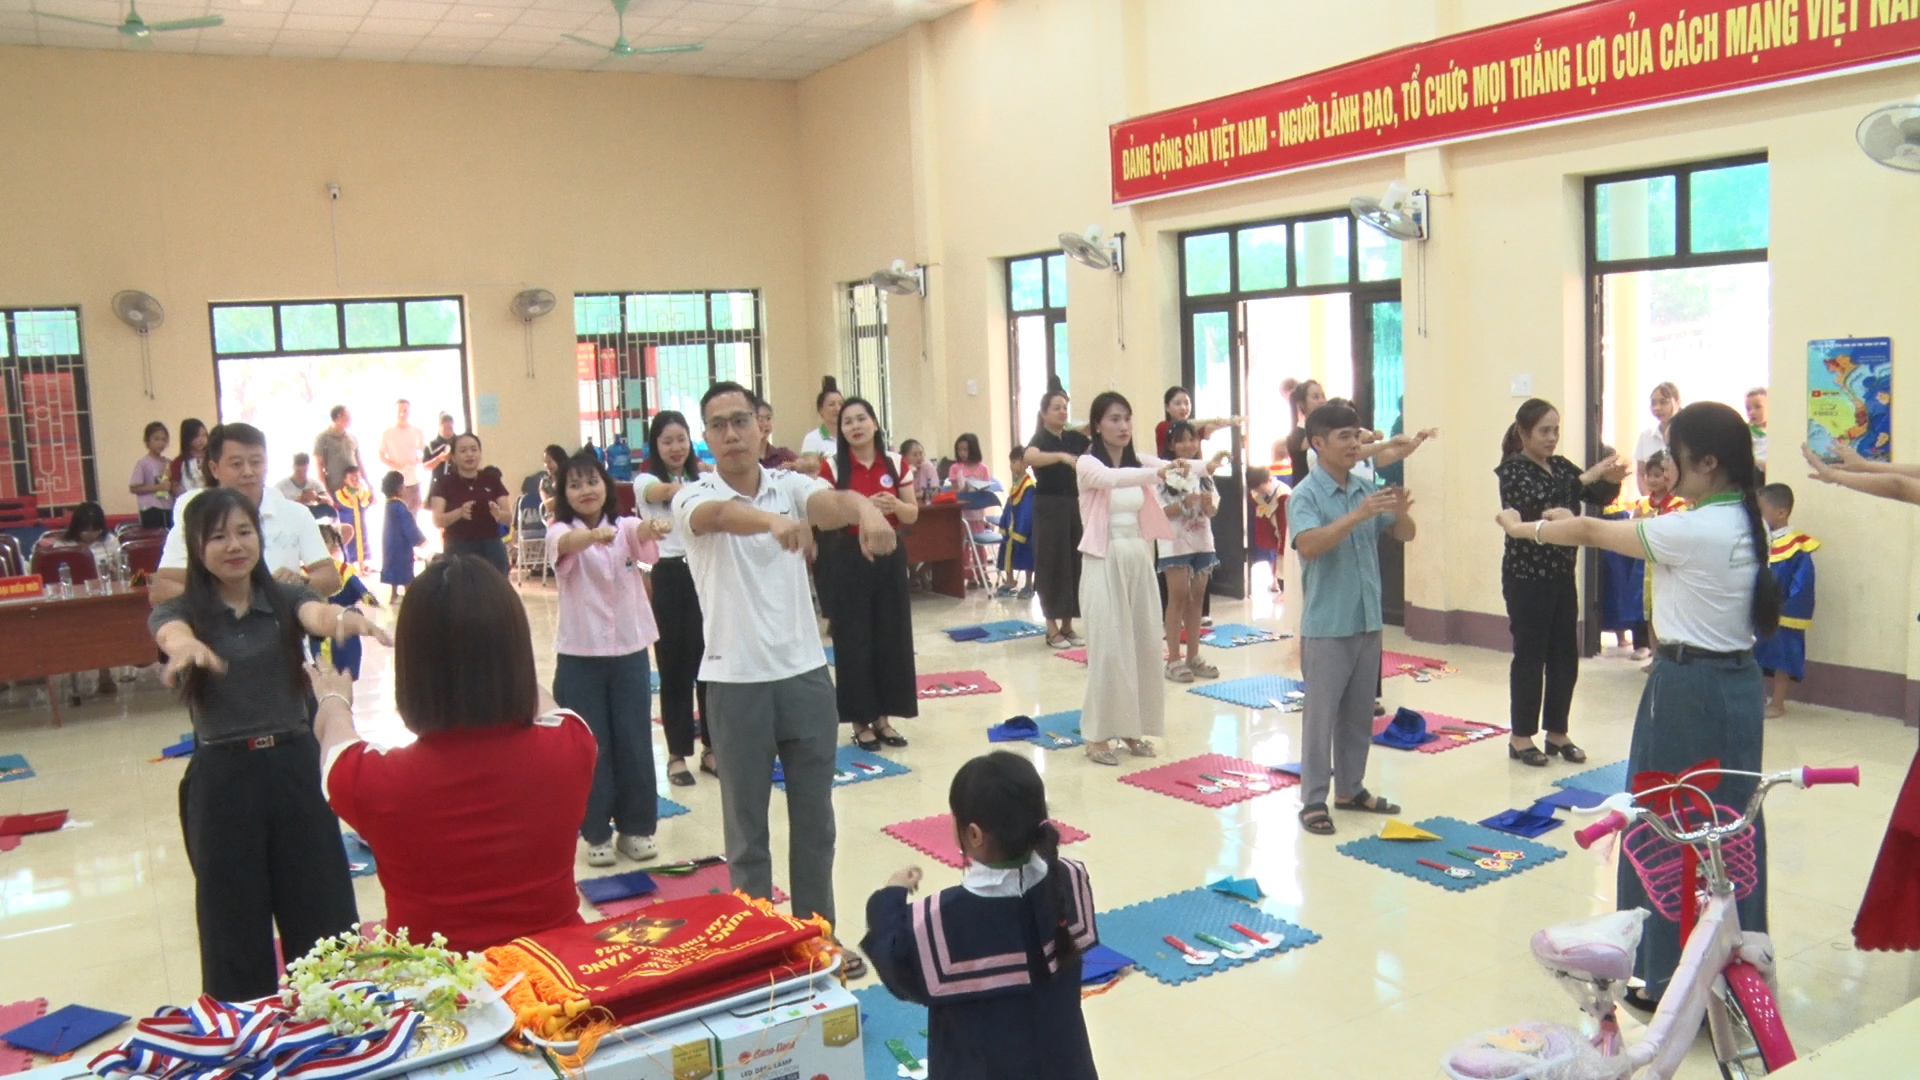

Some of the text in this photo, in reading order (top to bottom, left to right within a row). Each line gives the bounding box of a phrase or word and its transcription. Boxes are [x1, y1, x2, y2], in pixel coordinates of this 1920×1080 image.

[1122, 134, 1151, 181] ĐẢNG
[1153, 134, 1182, 180] CỘNG
[1185, 118, 1208, 168] SẢN
[1211, 118, 1236, 167] VIỆT
[1238, 116, 1267, 156] NAM
[1279, 95, 1319, 147] NGƯỜI
[1323, 92, 1360, 137] LÃNH
[1364, 86, 1398, 136] ĐẠO,
[1401, 63, 1420, 121] TỔ
[1425, 60, 1468, 117] CHỨC
[1472, 60, 1506, 113] MỌI
[1510, 37, 1570, 99] THẮNG
[1576, 31, 1606, 95] LỢI
[1612, 11, 1654, 79] CỦA
[1659, 9, 1718, 70] CÁCH
[1726, 0, 1798, 64] MẠNG
[741, 1070, 753, 1078] LED
